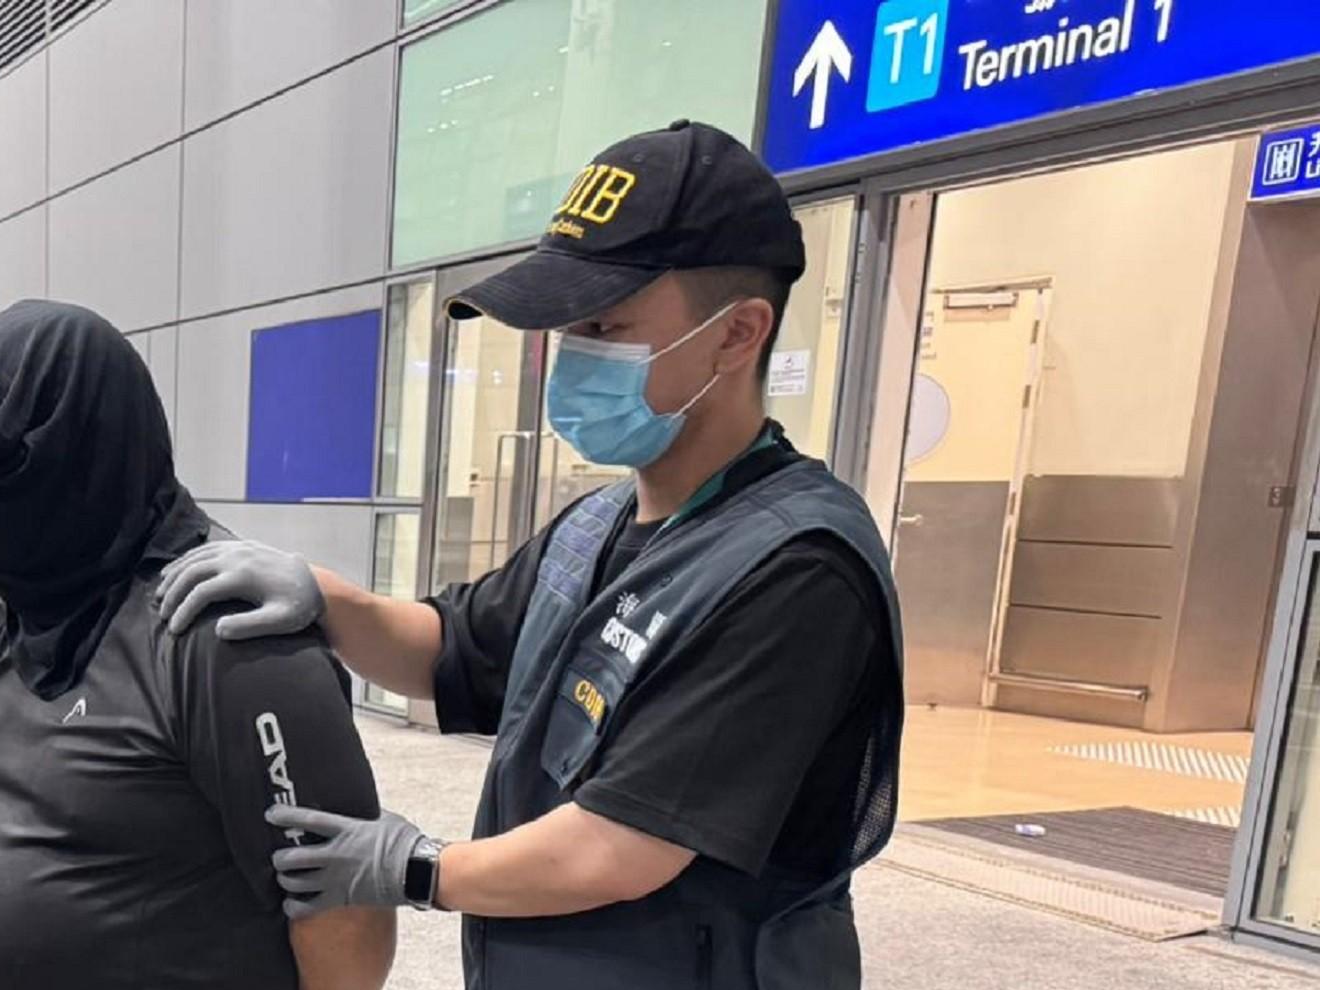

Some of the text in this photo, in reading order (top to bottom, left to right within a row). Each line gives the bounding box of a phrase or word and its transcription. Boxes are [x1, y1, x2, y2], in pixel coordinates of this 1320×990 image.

[883, 12, 939, 84] T1
[958, 0, 1174, 90] Terminal 1
